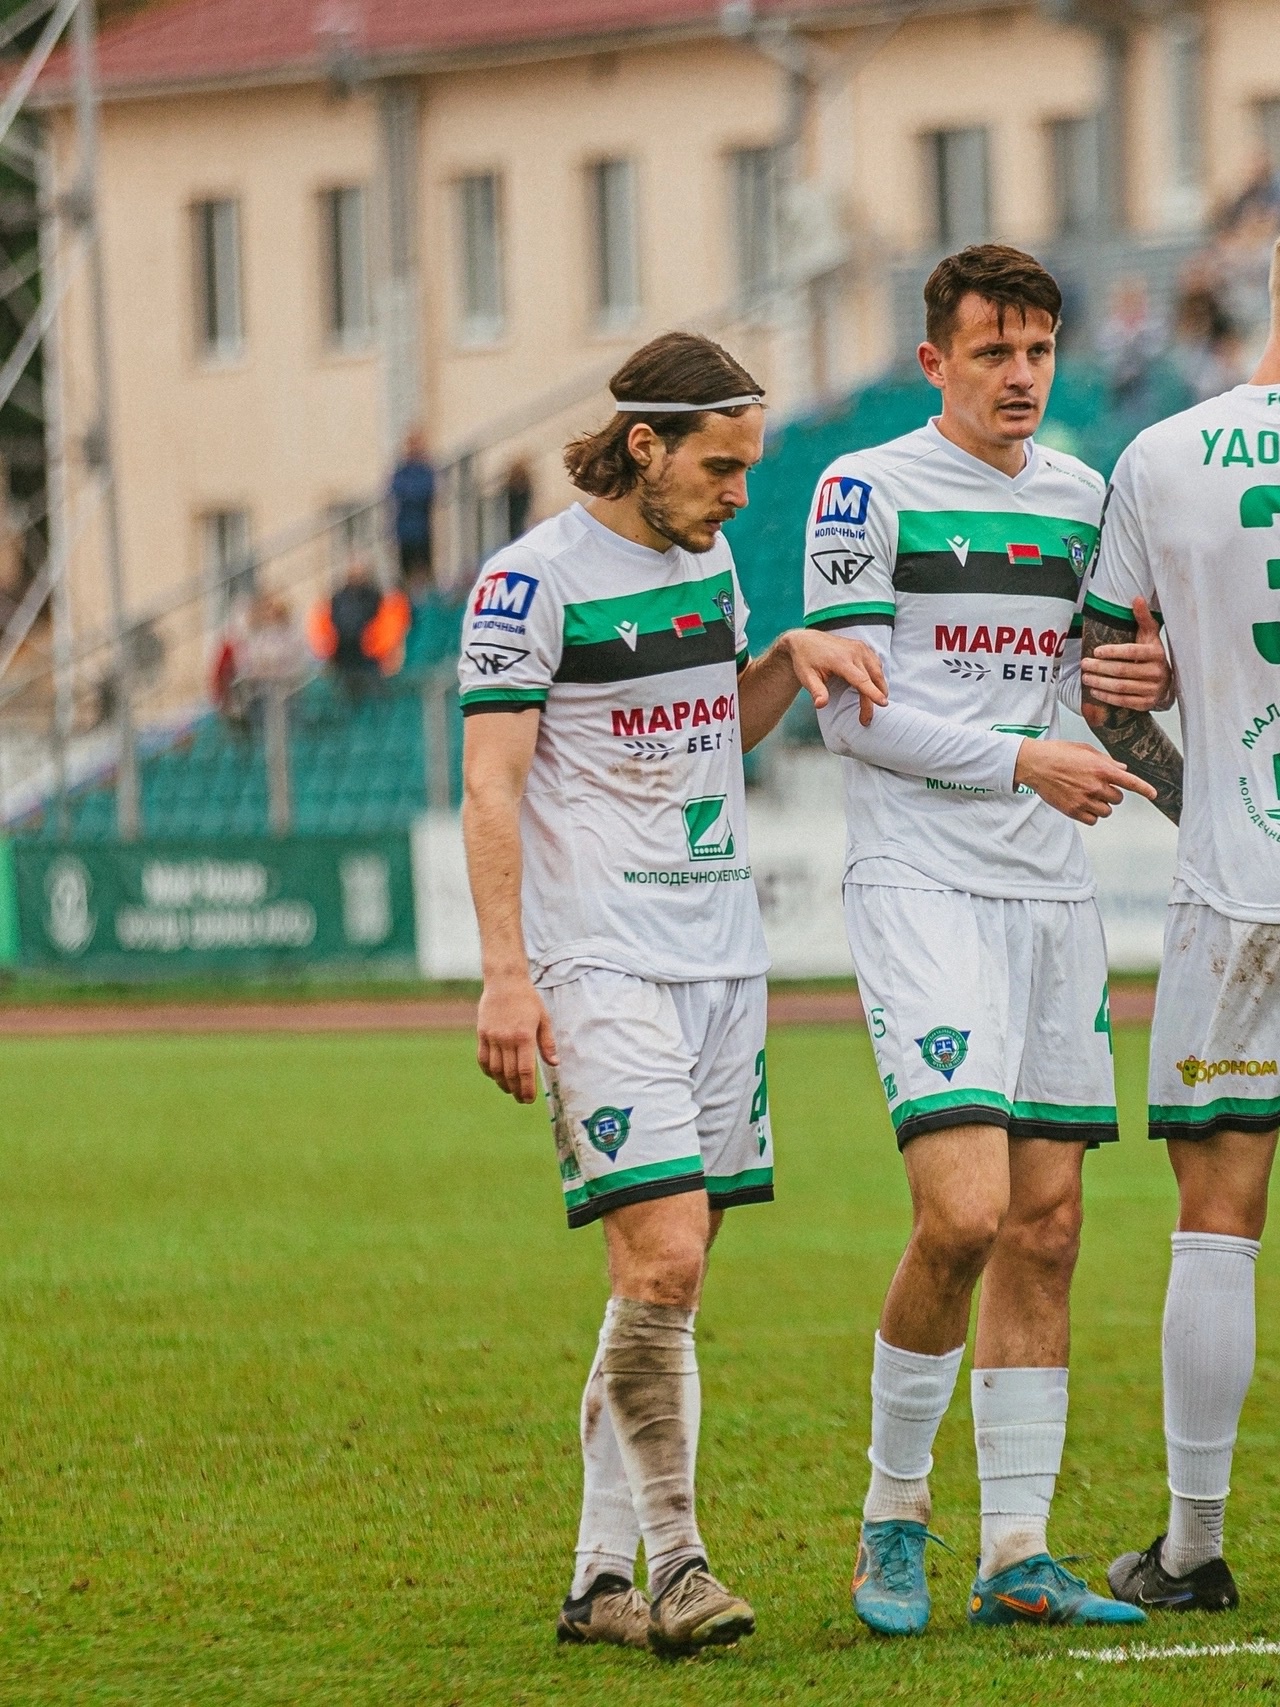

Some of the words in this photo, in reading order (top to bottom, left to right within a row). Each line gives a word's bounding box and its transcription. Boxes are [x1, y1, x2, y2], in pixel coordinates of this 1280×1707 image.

[814, 527, 866, 541] МОЛОЧНЫЙ
[1003, 663, 1048, 682] БЕТ
[687, 733, 722, 754] БЕТ
